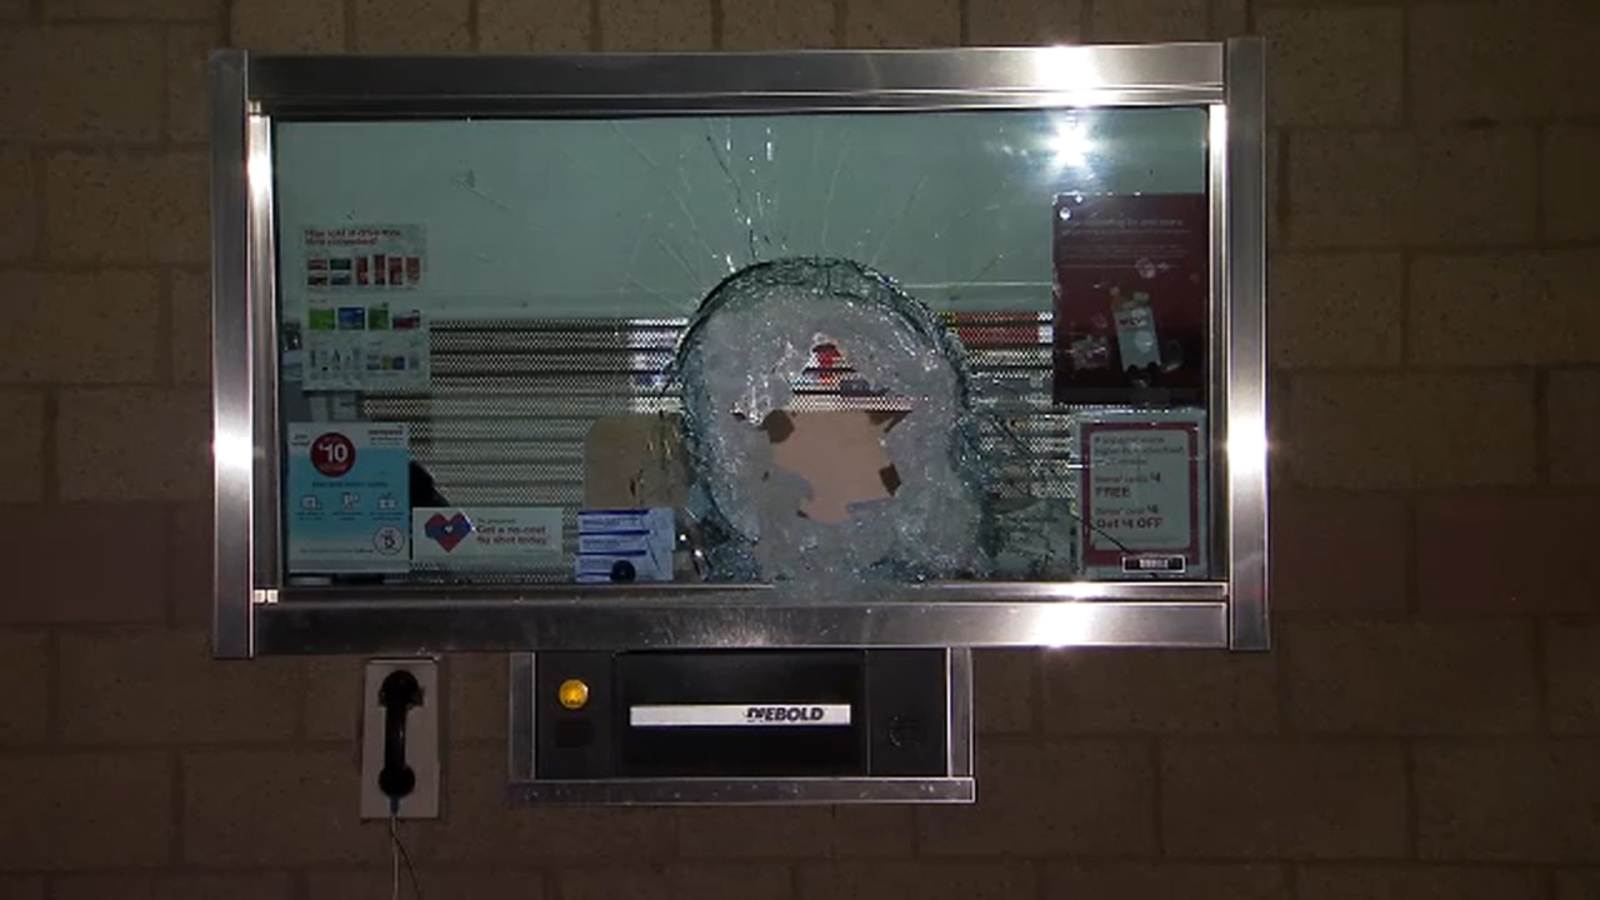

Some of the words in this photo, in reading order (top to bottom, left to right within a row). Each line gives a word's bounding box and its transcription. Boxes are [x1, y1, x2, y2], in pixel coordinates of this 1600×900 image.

[1095, 487, 1131, 498] FREE
[1137, 517, 1162, 528] OFF
[475, 525, 495, 535] Get
[507, 525, 546, 535] no-cost
[493, 535, 516, 545] shot
[746, 708, 824, 722] DIEBOLD
